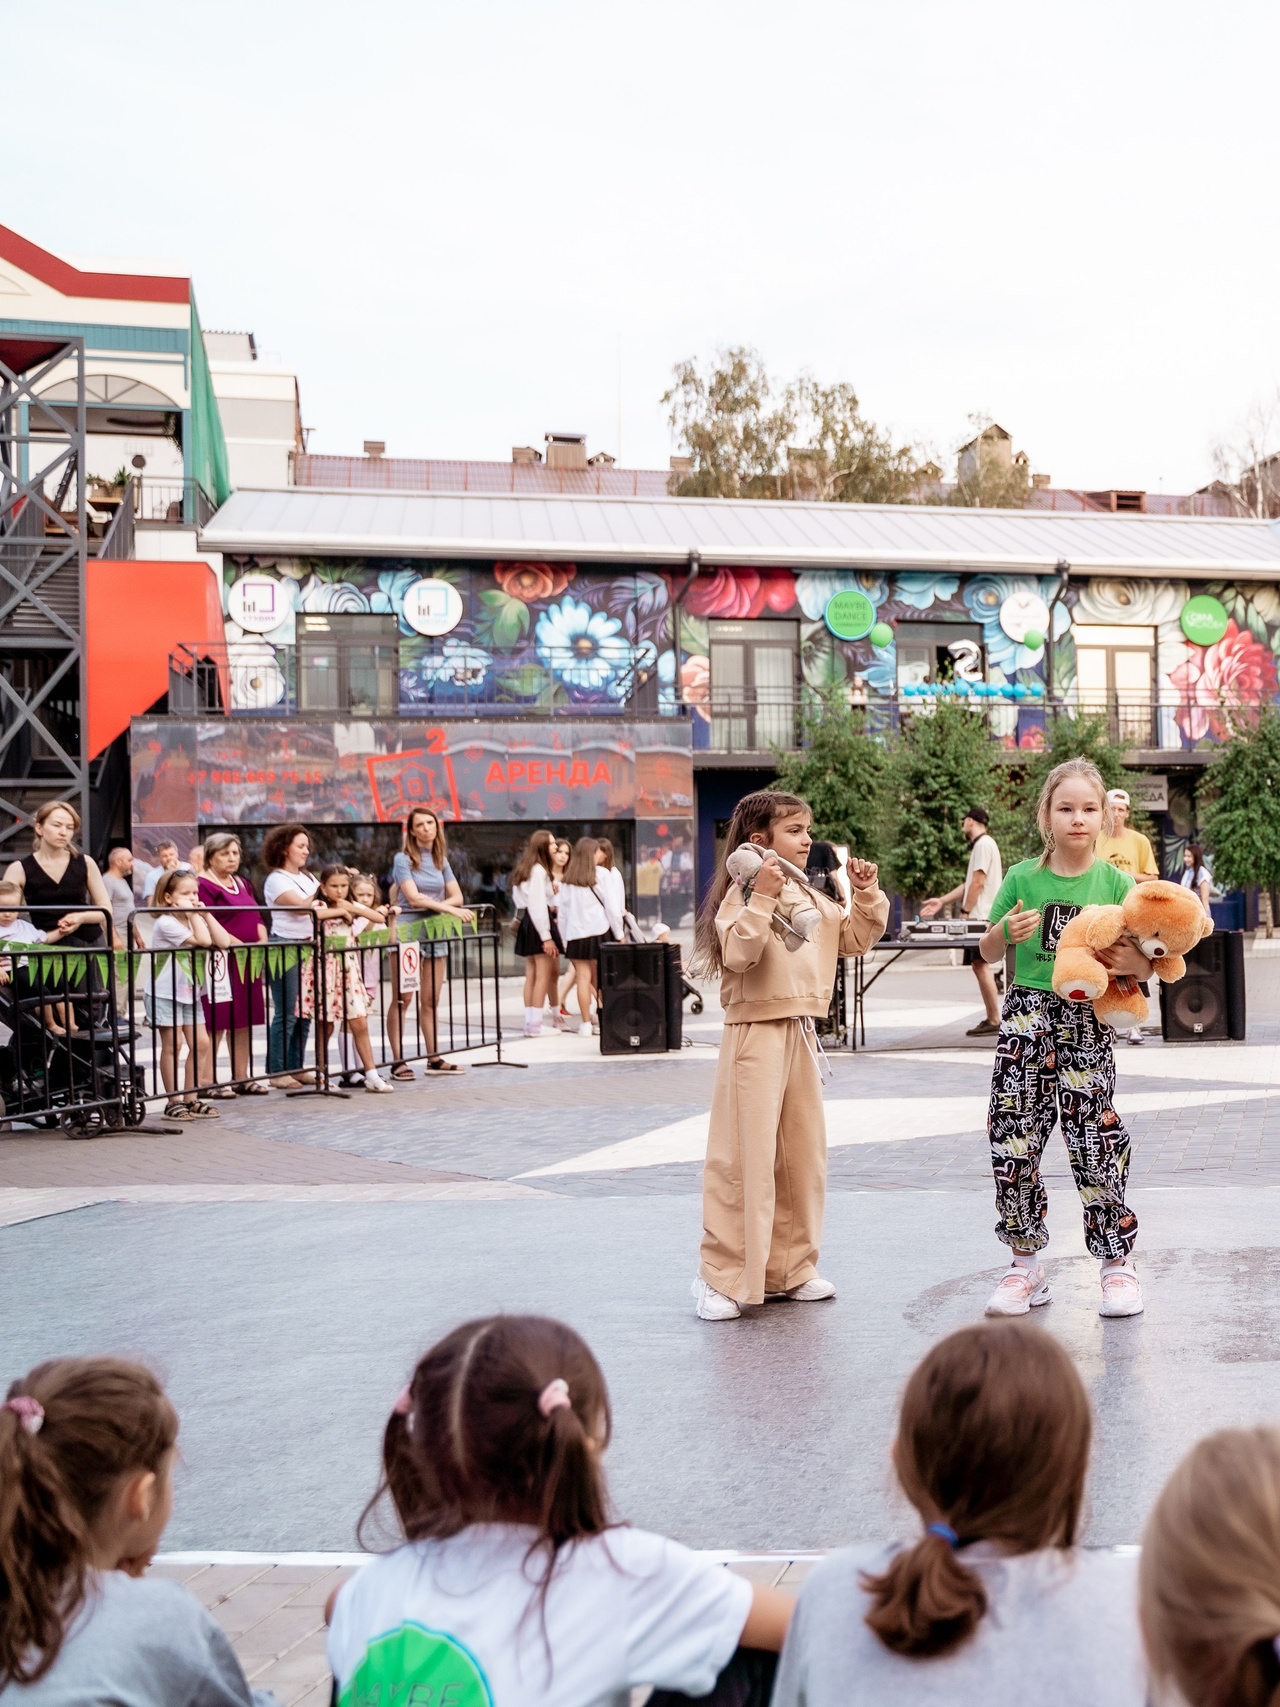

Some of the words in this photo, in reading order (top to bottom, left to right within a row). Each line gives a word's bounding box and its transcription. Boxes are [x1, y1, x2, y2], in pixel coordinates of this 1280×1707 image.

[834, 601, 867, 610] MAYBE
[835, 612, 867, 621] DANCE
[426, 728, 449, 753] 2
[187, 770, 207, 783] +7
[210, 770, 241, 784] 965
[245, 770, 277, 784] 669
[281, 770, 300, 784] 75
[304, 770, 323, 784] 15
[485, 760, 612, 789] АРЕНДА
